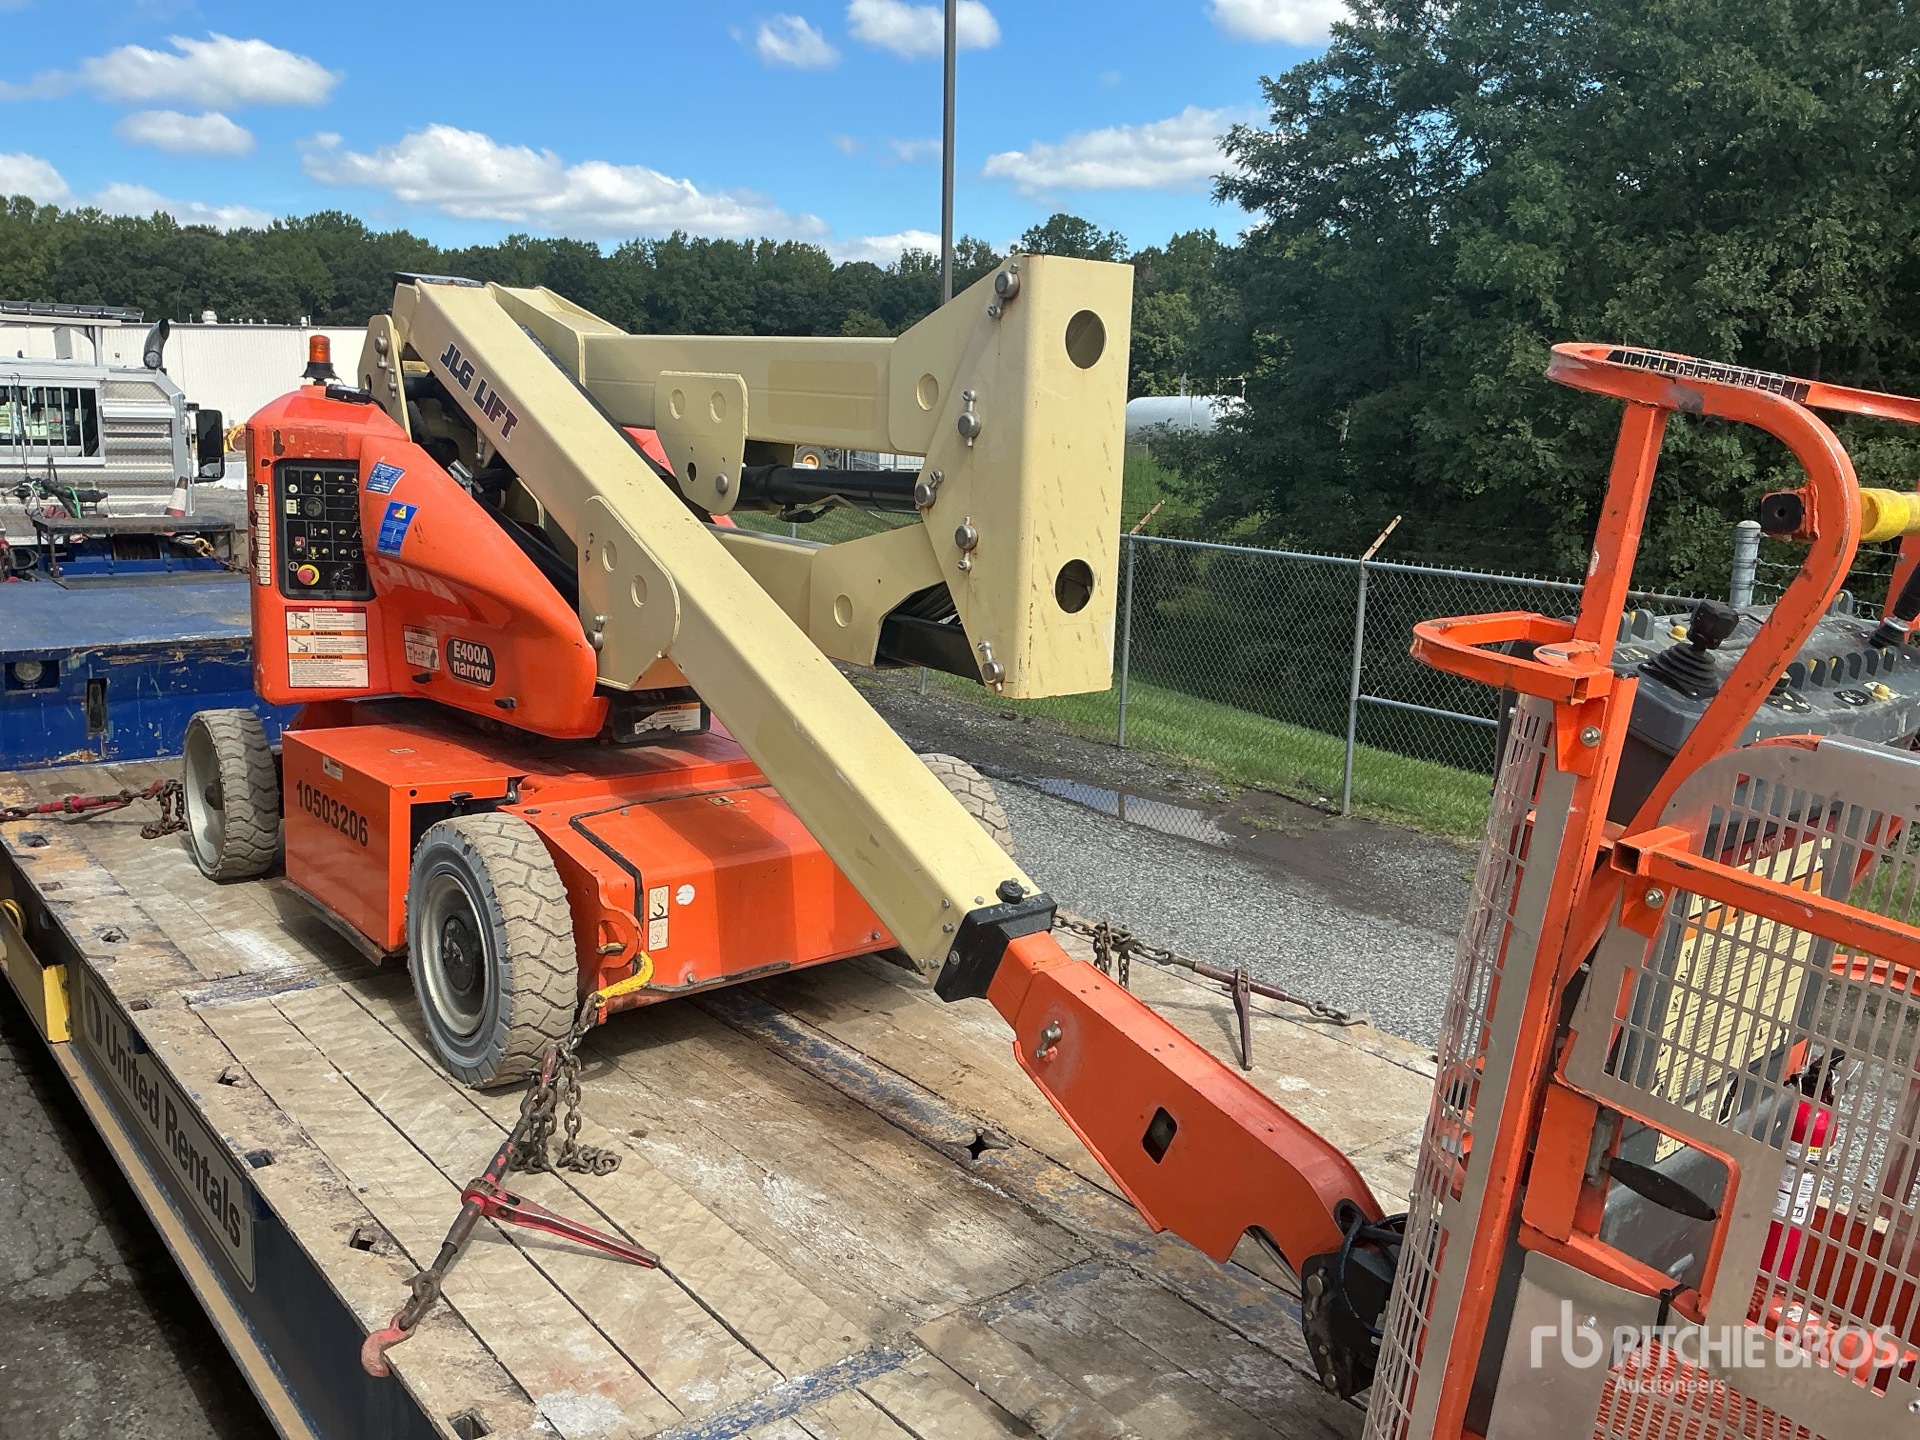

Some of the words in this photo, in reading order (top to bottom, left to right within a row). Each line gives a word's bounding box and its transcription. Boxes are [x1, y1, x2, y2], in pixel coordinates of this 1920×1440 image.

[440, 342, 476, 392] JLG
[472, 377, 519, 442] LIFT
[453, 640, 489, 666] E400A
[453, 660, 492, 682] narrow
[296, 780, 369, 847] 10503206
[105, 1013, 160, 1130] United
[164, 1095, 241, 1249] Rentals
